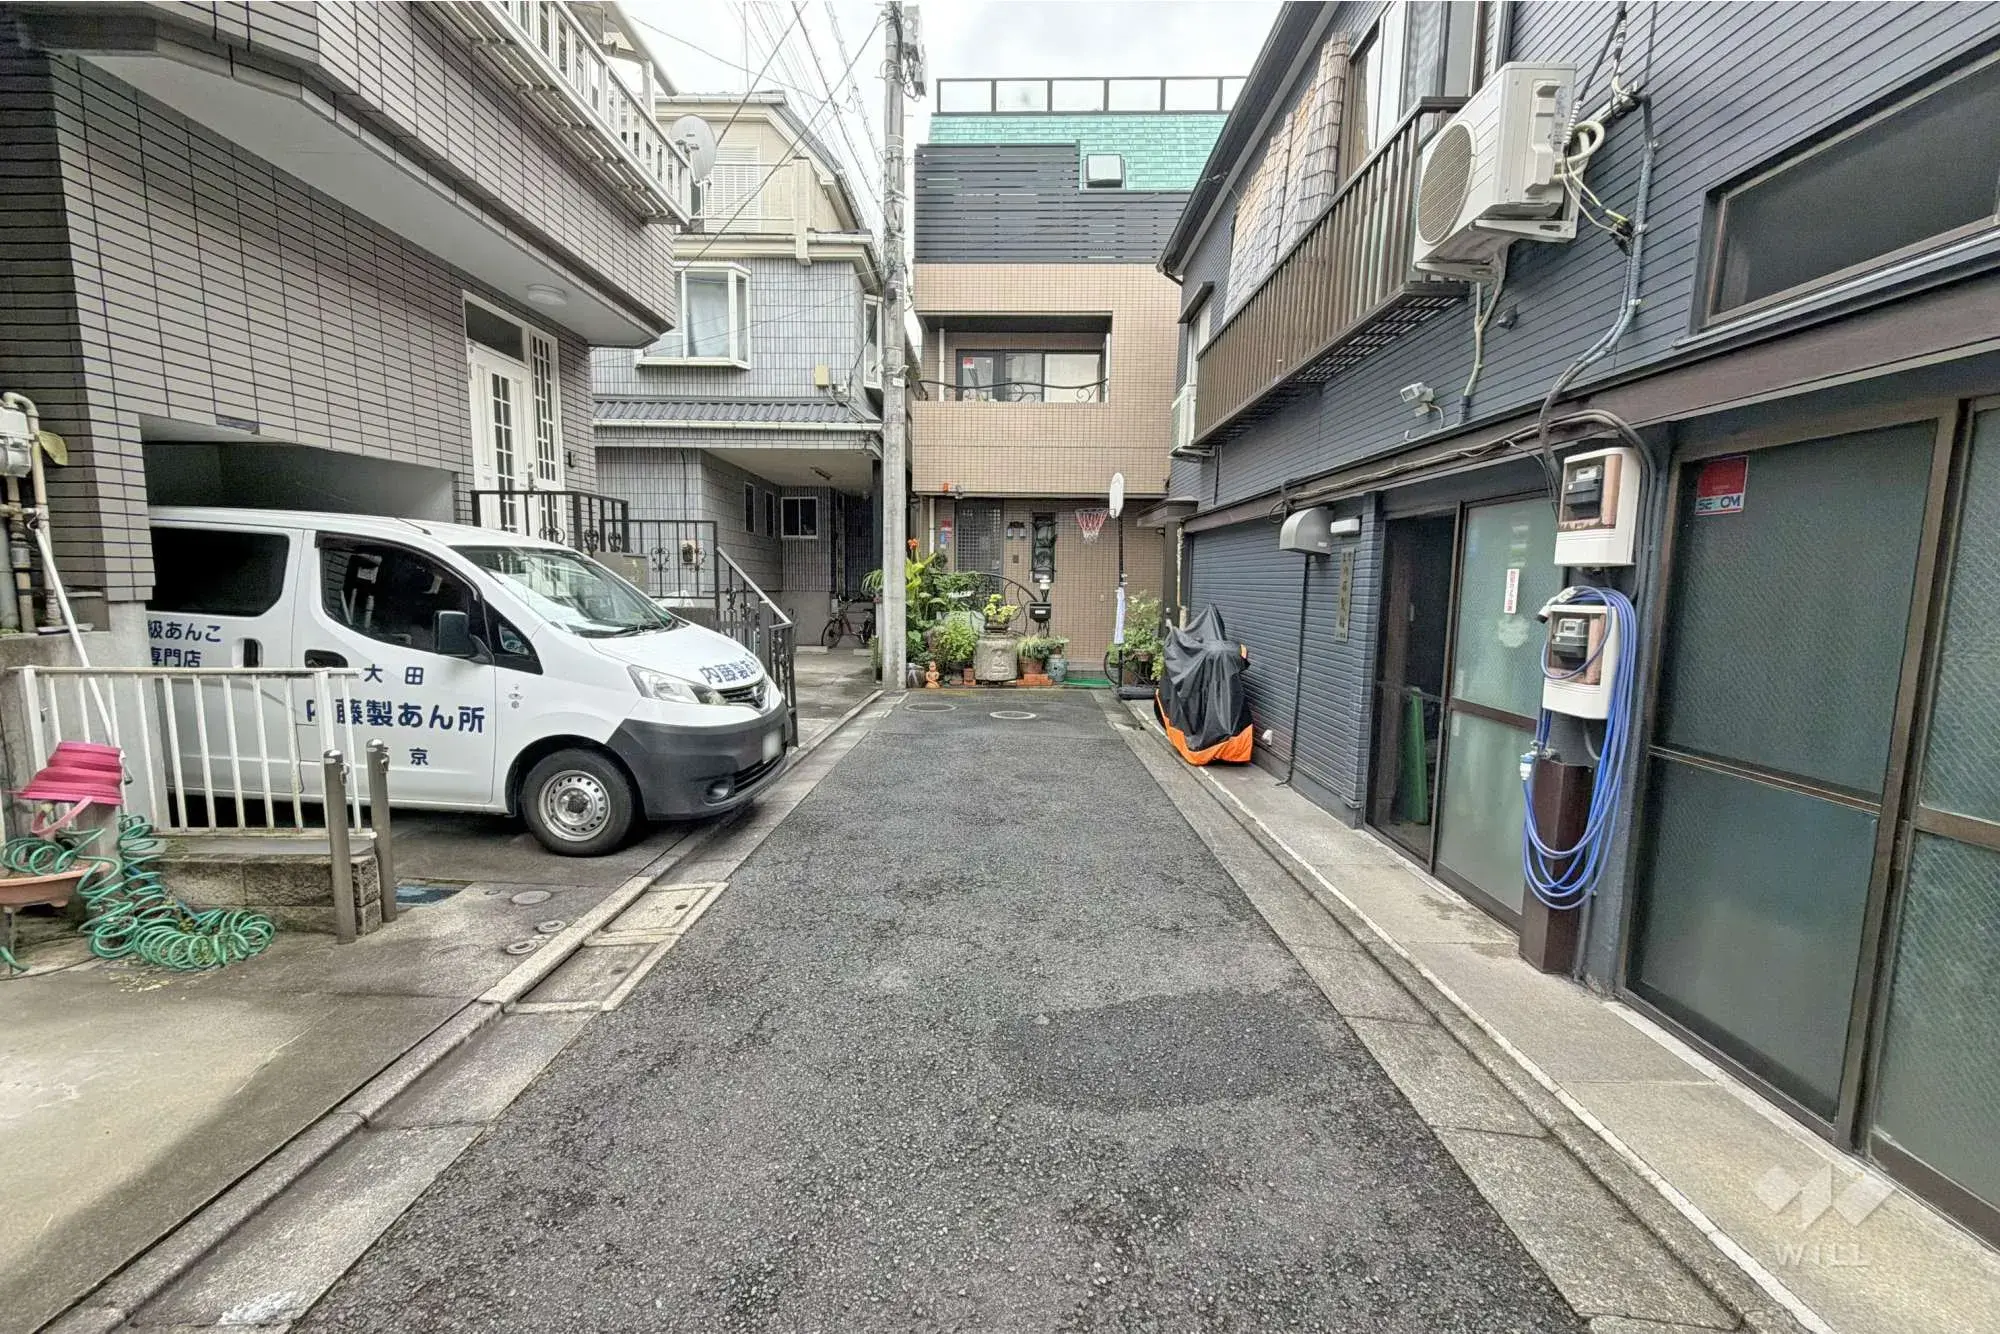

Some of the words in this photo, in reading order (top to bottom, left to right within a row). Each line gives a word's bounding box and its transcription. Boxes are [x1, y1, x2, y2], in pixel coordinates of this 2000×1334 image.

[1698, 495, 1741, 510] SEOM
[151, 646, 201, 668] 専門店
